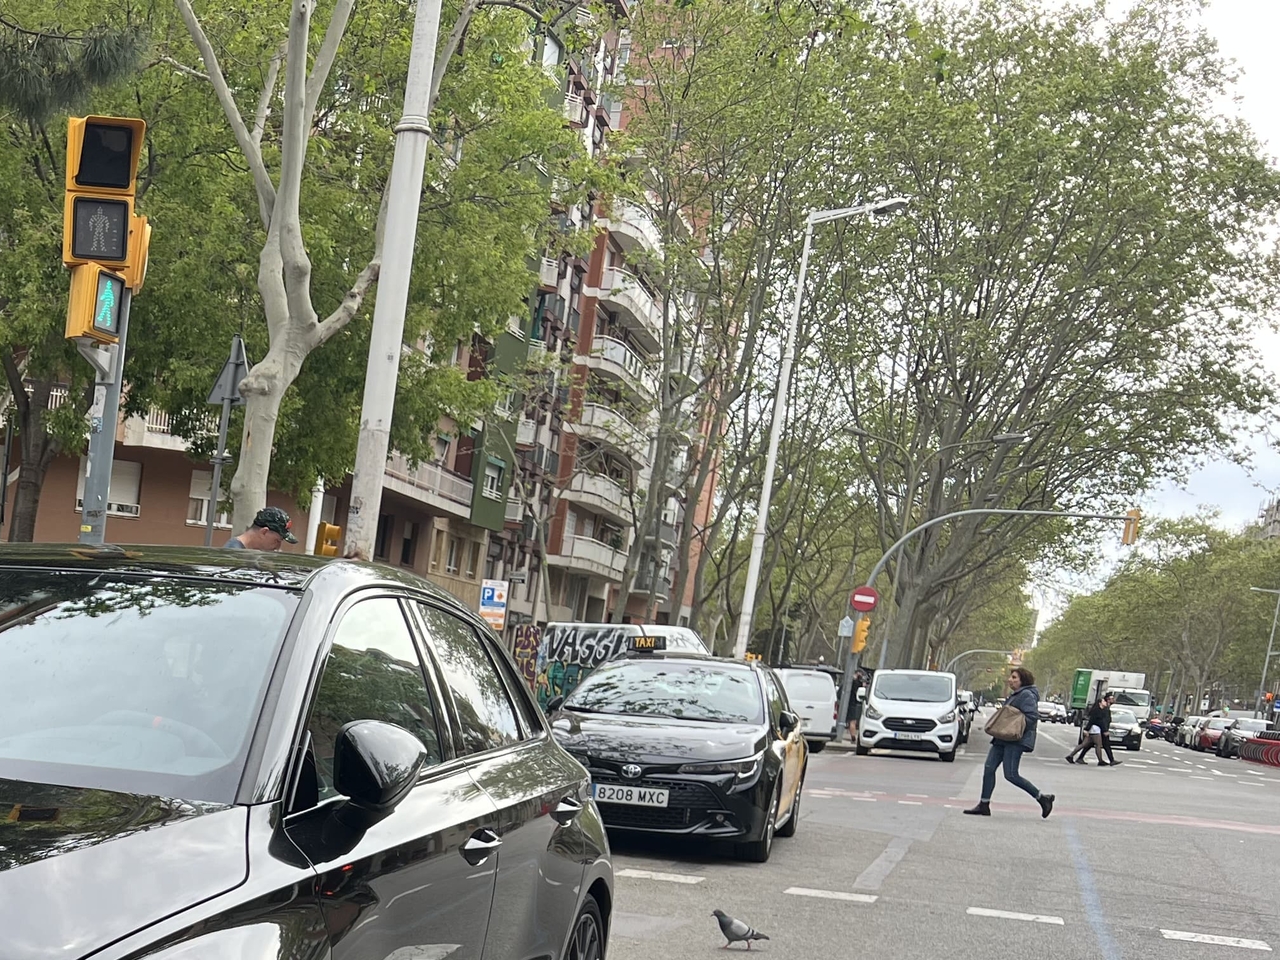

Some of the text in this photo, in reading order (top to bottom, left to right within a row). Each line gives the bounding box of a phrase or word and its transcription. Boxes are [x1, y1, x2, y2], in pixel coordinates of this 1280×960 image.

[484, 588, 493, 601] P
[634, 636, 655, 648] TAXI
[597, 786, 665, 805] 8208 MXC
